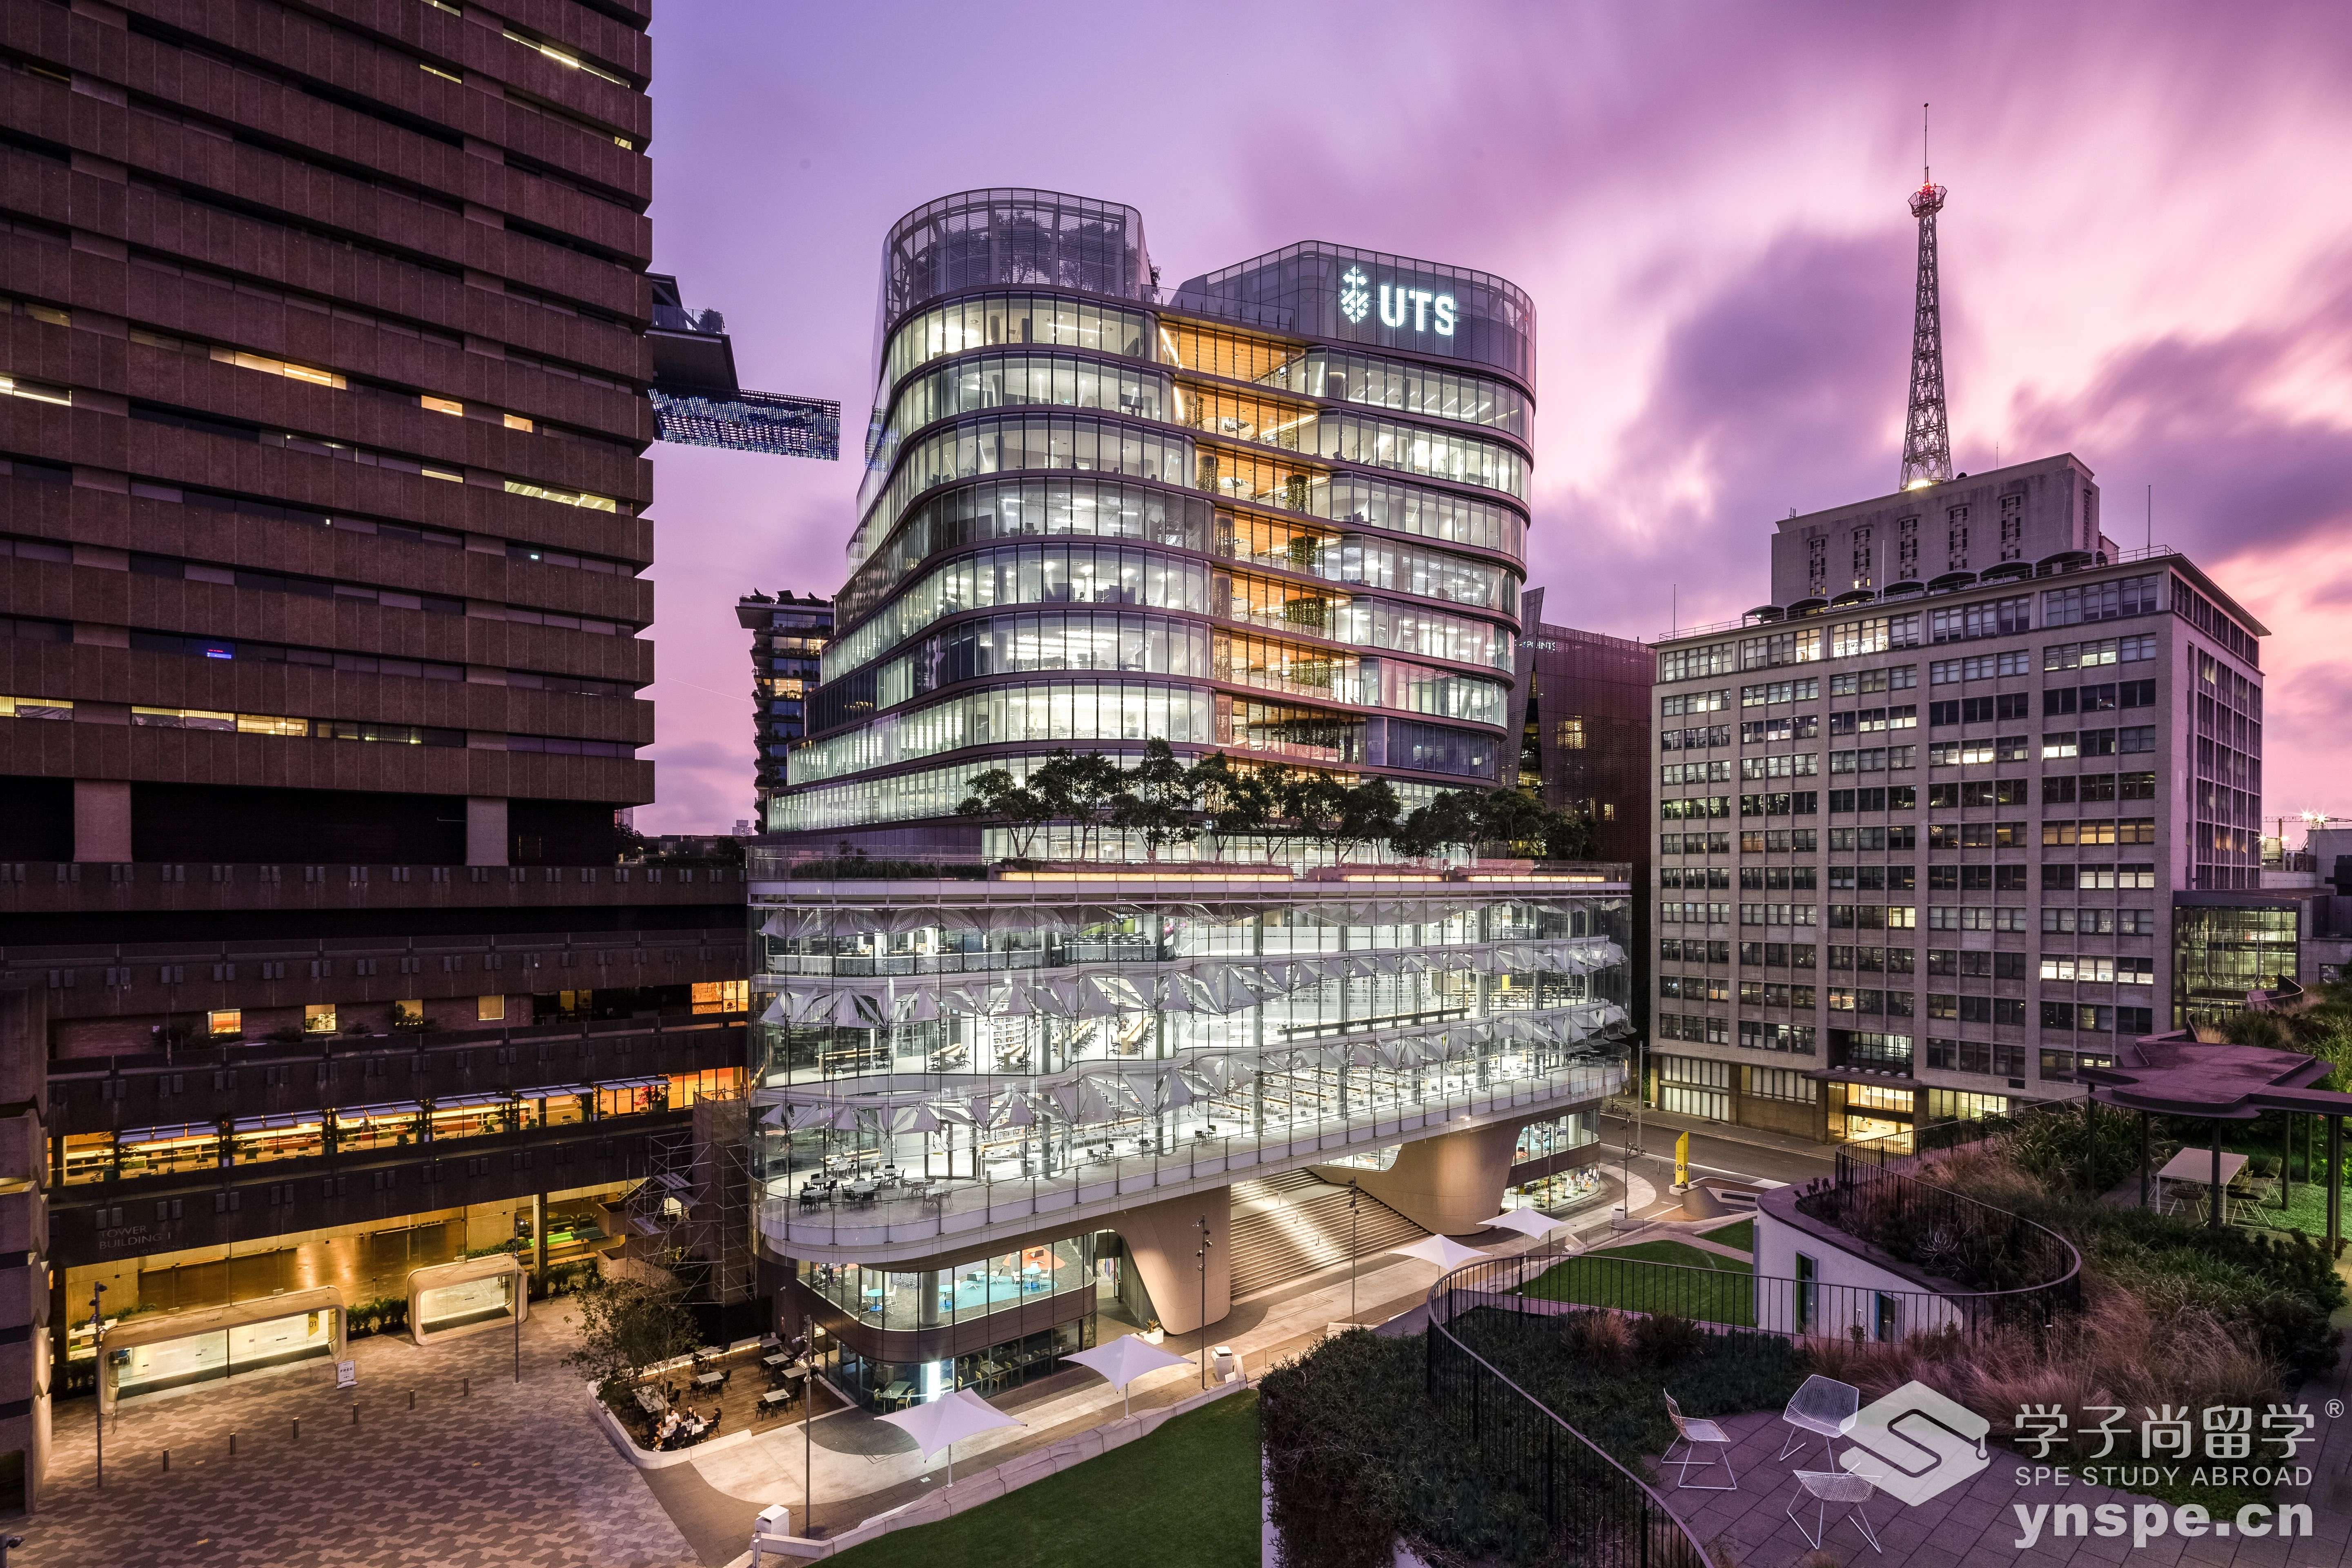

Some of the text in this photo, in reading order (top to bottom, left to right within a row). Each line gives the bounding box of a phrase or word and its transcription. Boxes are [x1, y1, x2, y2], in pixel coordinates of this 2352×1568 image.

[1380, 285, 1457, 336] UTS
[99, 1225, 147, 1238] TOWER
[99, 1234, 162, 1250] BUILDING
[151, 1244, 184, 1253] BUILDING
